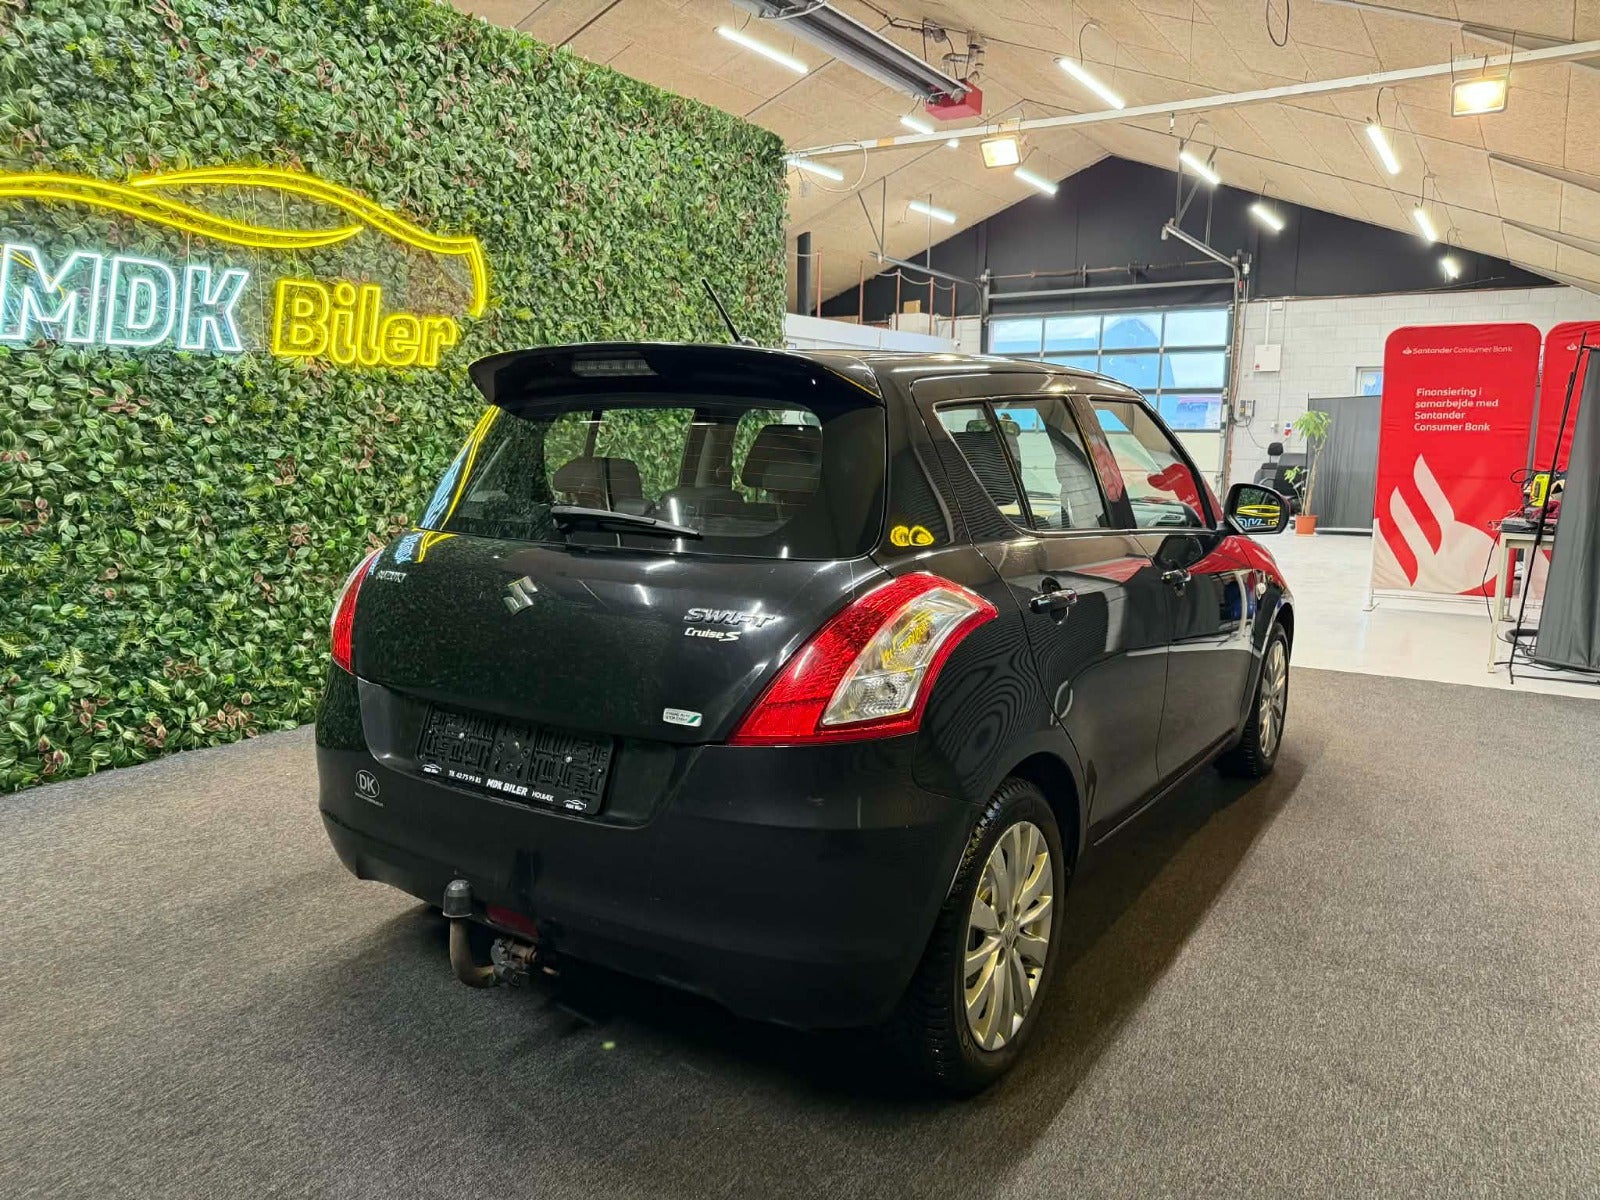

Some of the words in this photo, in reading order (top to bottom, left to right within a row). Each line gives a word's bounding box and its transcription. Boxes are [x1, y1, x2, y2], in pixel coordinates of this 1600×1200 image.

[0, 243, 250, 352] MDK
[272, 279, 458, 367] Biler
[1412, 347, 1453, 355] Santander
[1453, 346, 1492, 354] Consumer
[1493, 345, 1513, 353] Bank
[1416, 387, 1477, 398] Finansiering
[1415, 398, 1474, 409] samarbejde
[1476, 398, 1499, 407] med
[1414, 411, 1466, 420] Santander
[1413, 422, 1463, 431] Consumer
[1464, 422, 1491, 431] Bank
[684, 607, 777, 628] SWIFT
[359, 773, 376, 795] DK
[486, 778, 503, 790] MDK
[502, 782, 528, 797] BILER
